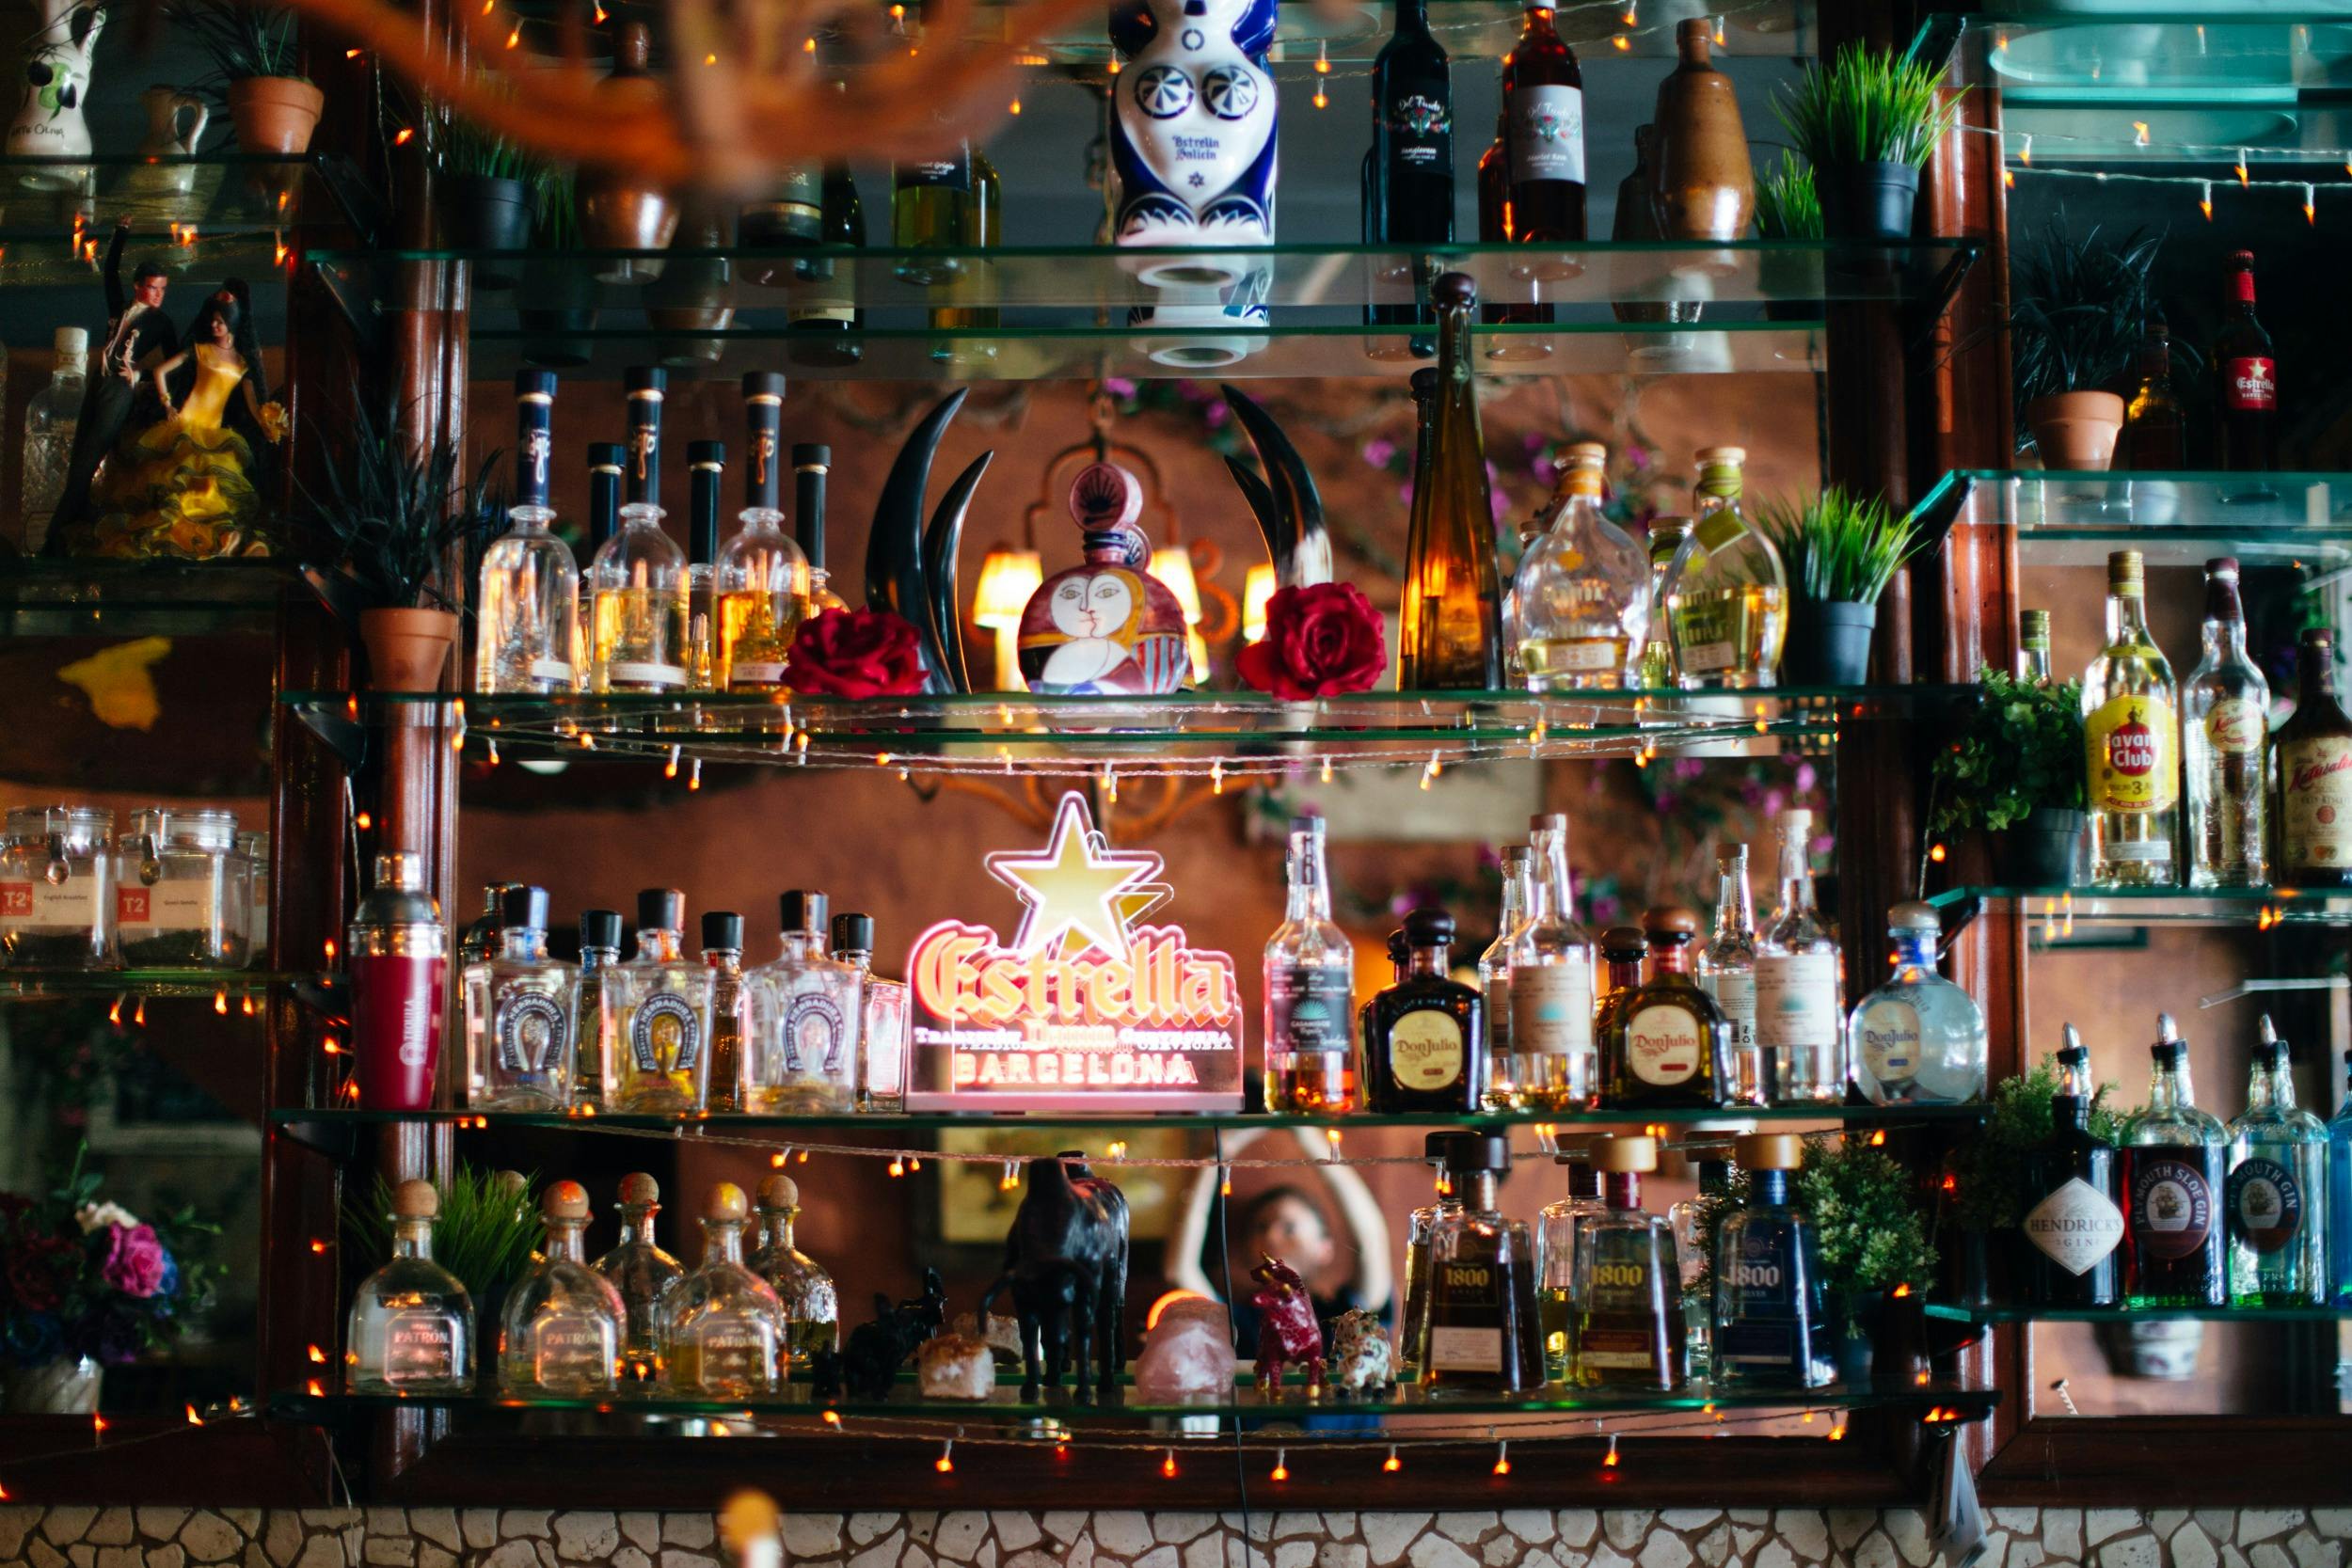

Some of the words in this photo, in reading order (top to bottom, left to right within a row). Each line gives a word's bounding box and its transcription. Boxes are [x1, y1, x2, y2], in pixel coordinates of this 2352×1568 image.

[2236, 376, 2275, 392] Estrella
[2113, 751, 2154, 768] Club
[5, 892, 27, 908] T2
[123, 896, 144, 913] T2
[914, 927, 1233, 1022] Estrella
[954, 1053, 1191, 1085] BARCELONA
[2137, 1165, 2172, 1225] PLYMOUTH
[2175, 1168, 2204, 1199] SLOE
[2195, 1200, 2207, 1227] GIN
[2280, 1181, 2298, 1209] GIN
[2063, 1239, 2093, 1247] GIN
[1445, 1267, 1490, 1287] 1800
[1590, 1264, 1643, 1286] 1800
[1729, 1265, 1779, 1288] 1800
